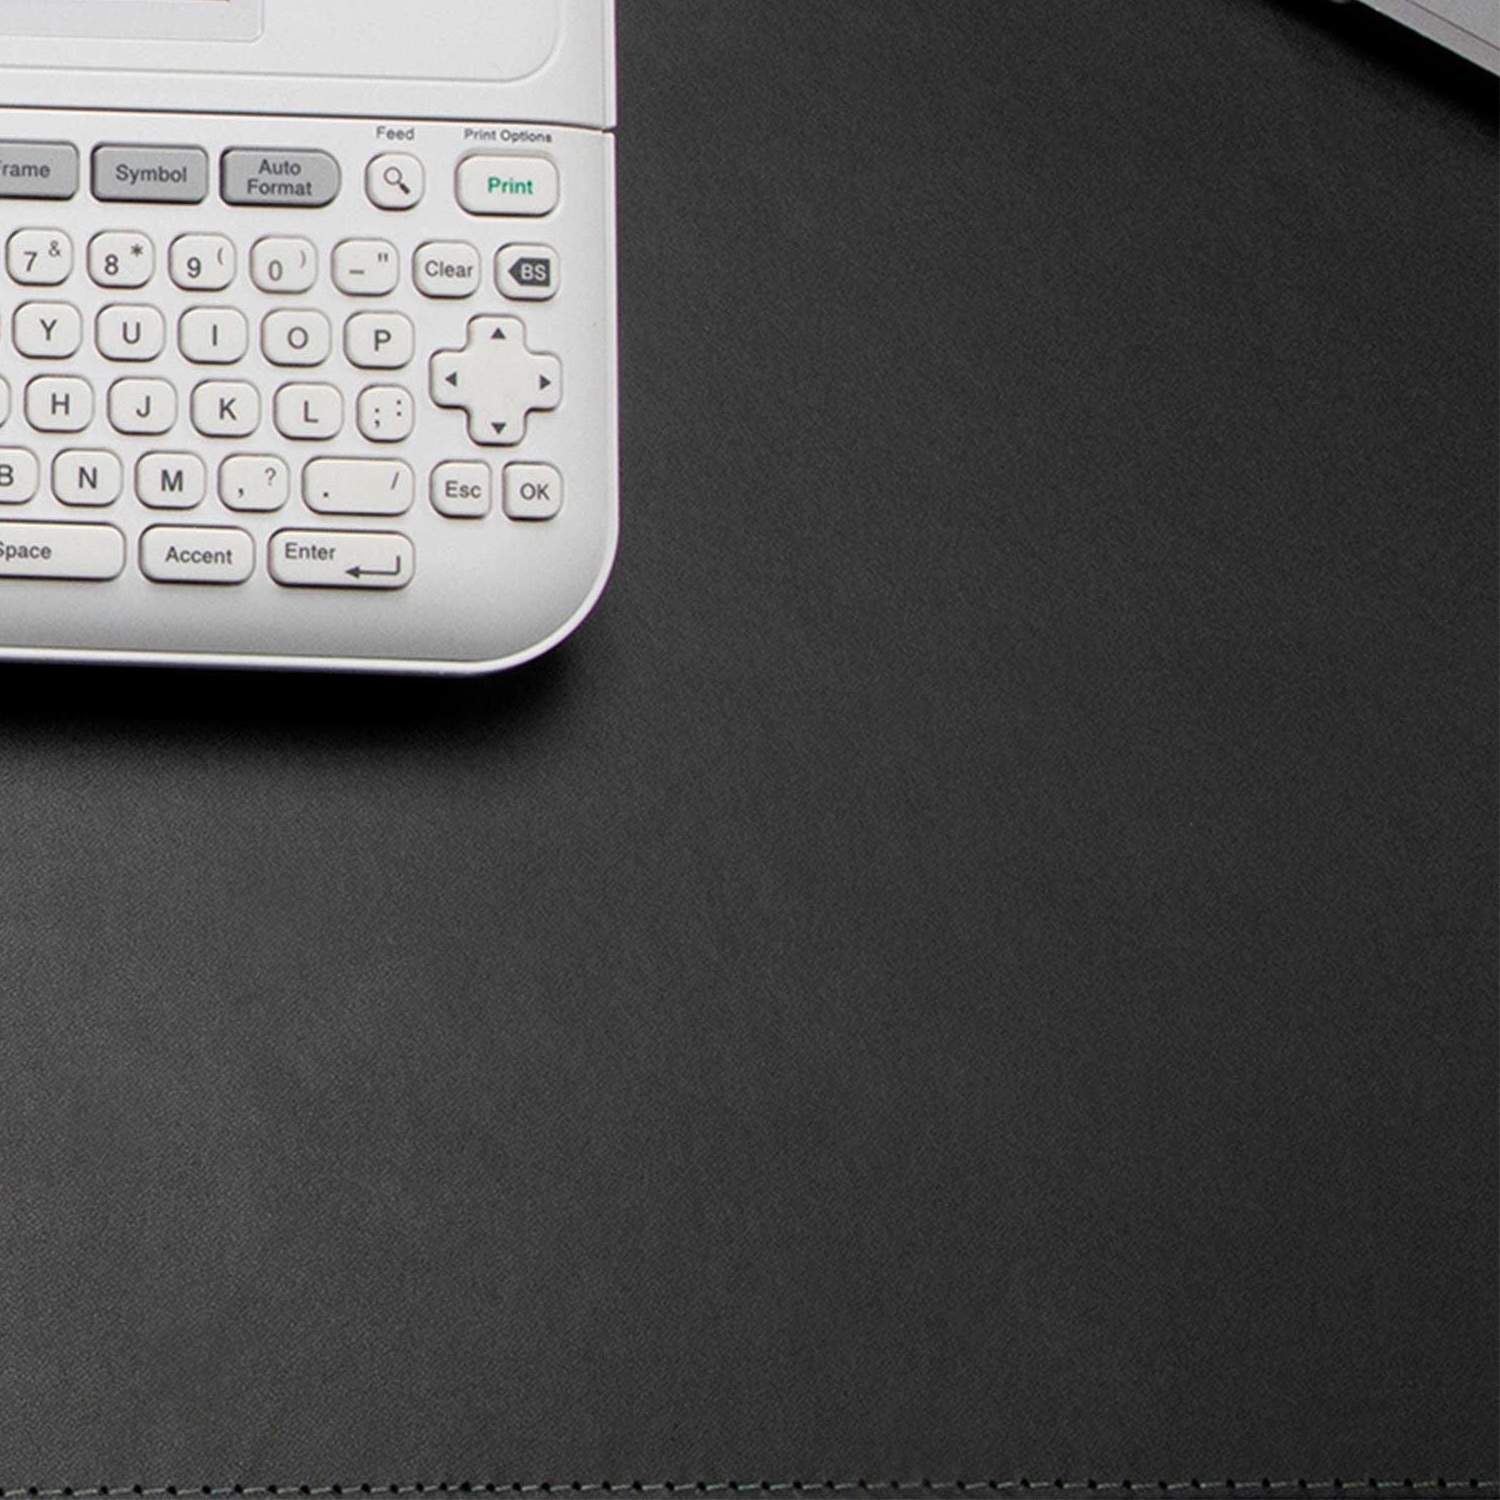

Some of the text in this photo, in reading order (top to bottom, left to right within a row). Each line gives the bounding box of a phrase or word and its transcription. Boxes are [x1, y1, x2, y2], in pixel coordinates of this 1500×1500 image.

[375, 126, 415, 140] Feed
[463, 128, 553, 144] Print Options
[115, 163, 188, 185] Symbol
[258, 159, 301, 176] Auto
[247, 179, 313, 197] Format
[487, 177, 534, 195] Print
[23, 251, 38, 273] 7
[104, 254, 119, 276] 8
[187, 256, 202, 279] 9
[424, 260, 473, 278] Clear
[521, 263, 547, 281] BS
[39, 318, 57, 341] Y
[122, 321, 141, 345] U
[212, 324, 218, 346] I
[287, 327, 309, 349] O
[374, 329, 392, 352] P
[51, 393, 70, 415] H
[136, 395, 151, 418] J
[219, 397, 237, 420] K
[304, 400, 319, 423] L
[78, 467, 97, 489] N
[160, 469, 183, 492] M
[445, 480, 481, 499] Esc
[520, 483, 550, 501] OK
[165, 546, 233, 565] Accent
[284, 542, 336, 561] Enter
